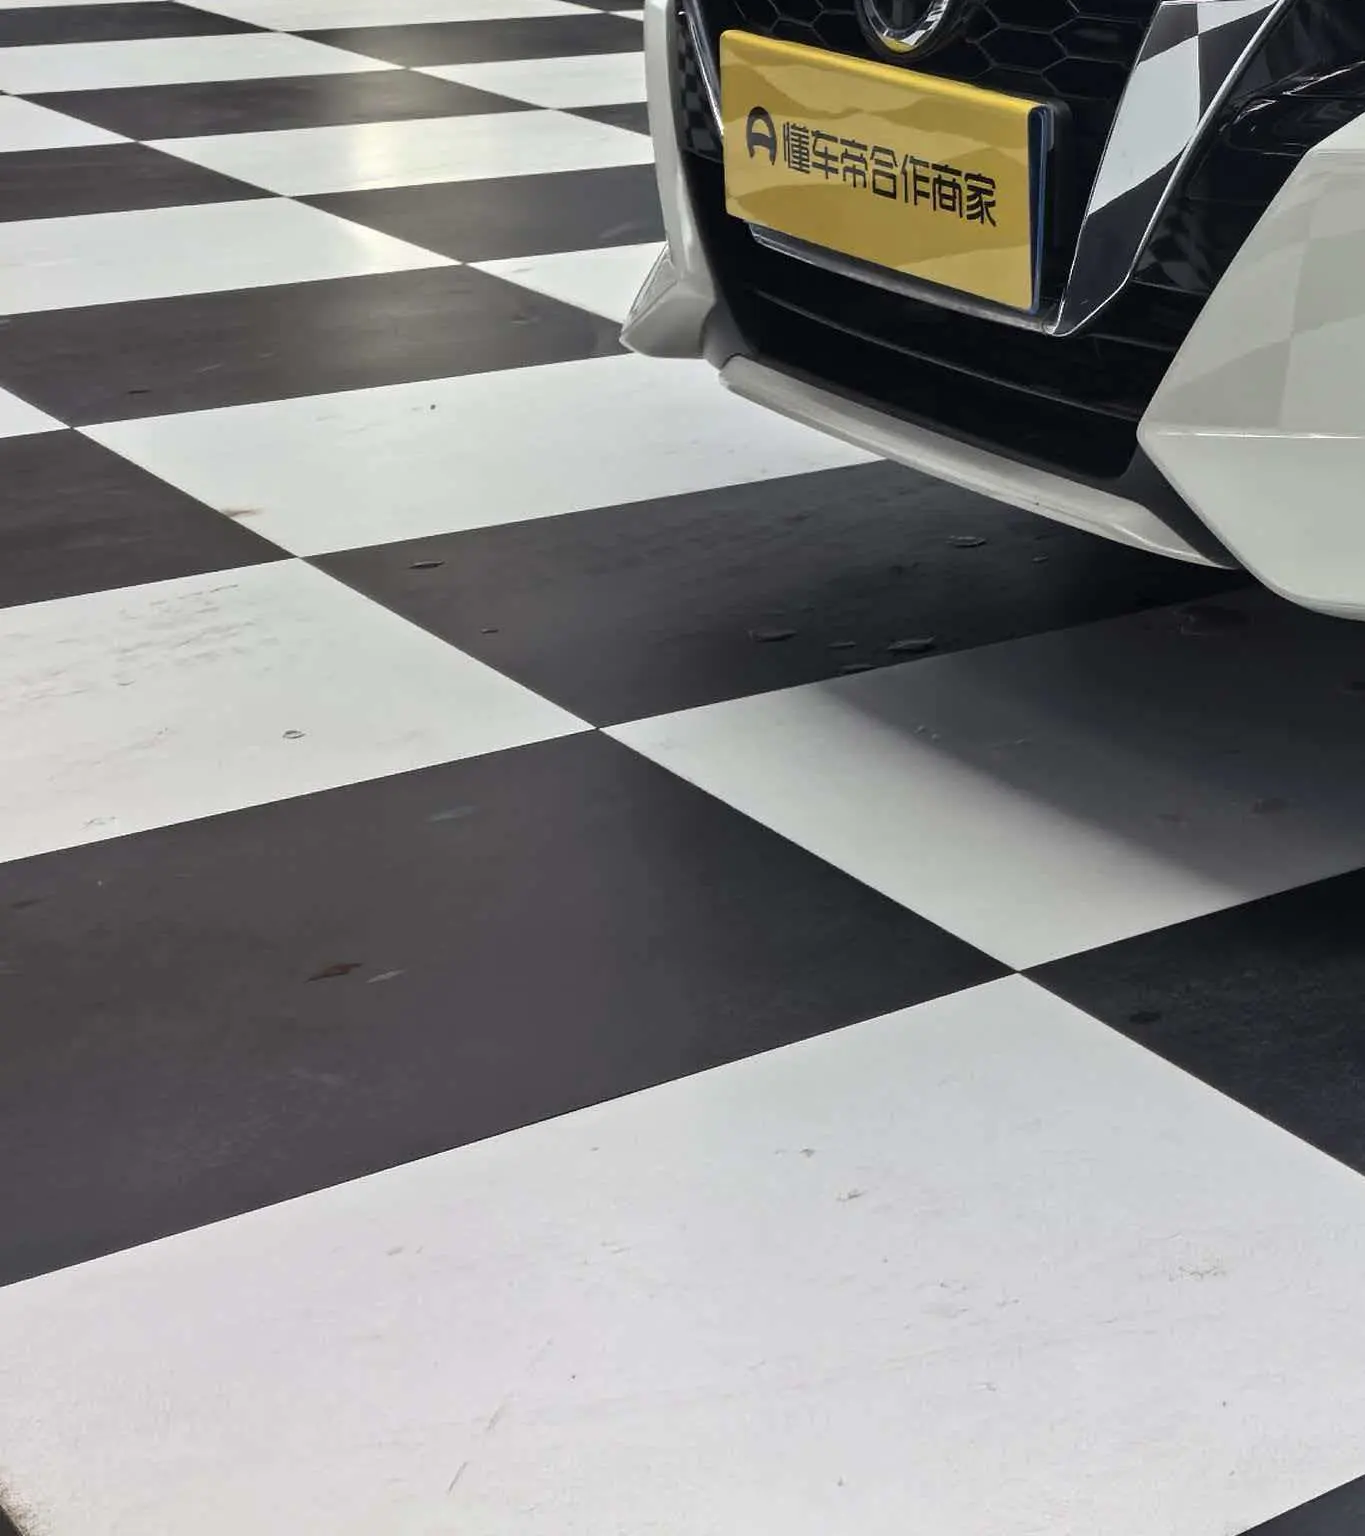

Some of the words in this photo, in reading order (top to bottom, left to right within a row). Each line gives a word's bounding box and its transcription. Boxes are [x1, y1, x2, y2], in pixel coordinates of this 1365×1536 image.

[781, 120, 997, 228] 懂车帝合作商家
